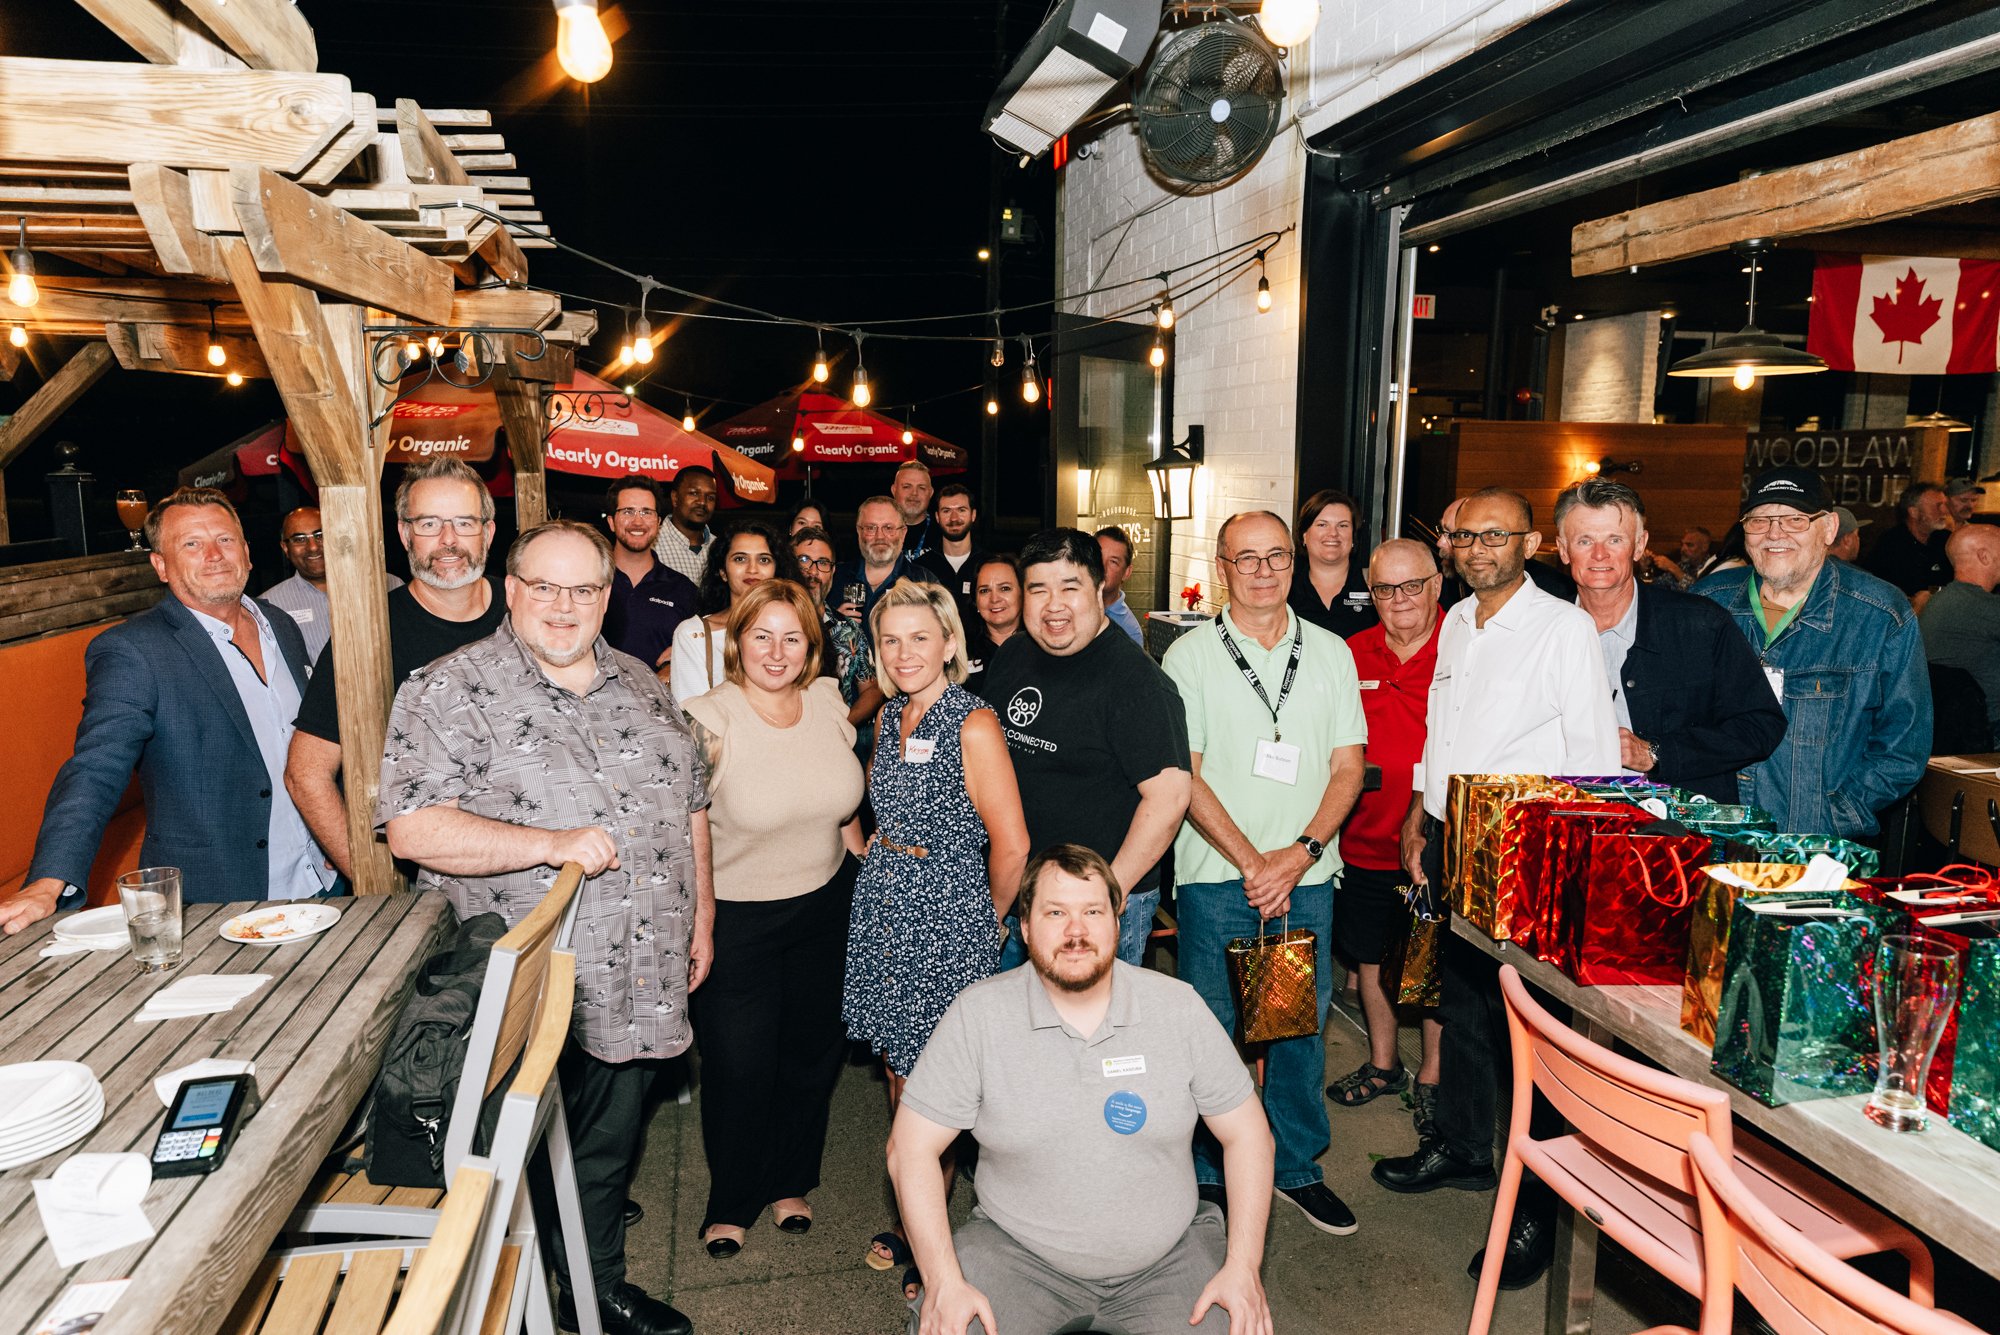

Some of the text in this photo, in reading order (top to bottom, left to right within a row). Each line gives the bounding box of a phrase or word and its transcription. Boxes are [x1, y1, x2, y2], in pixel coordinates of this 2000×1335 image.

[399, 435, 471, 456] Organic
[735, 443, 775, 457] Organic
[814, 443, 899, 457] Clearly Organic
[545, 443, 679, 472] learly Organic
[1217, 623, 1227, 640] ALL
[1243, 669, 1258, 686] ALL
[1007, 730, 1057, 752] CONNECTED
